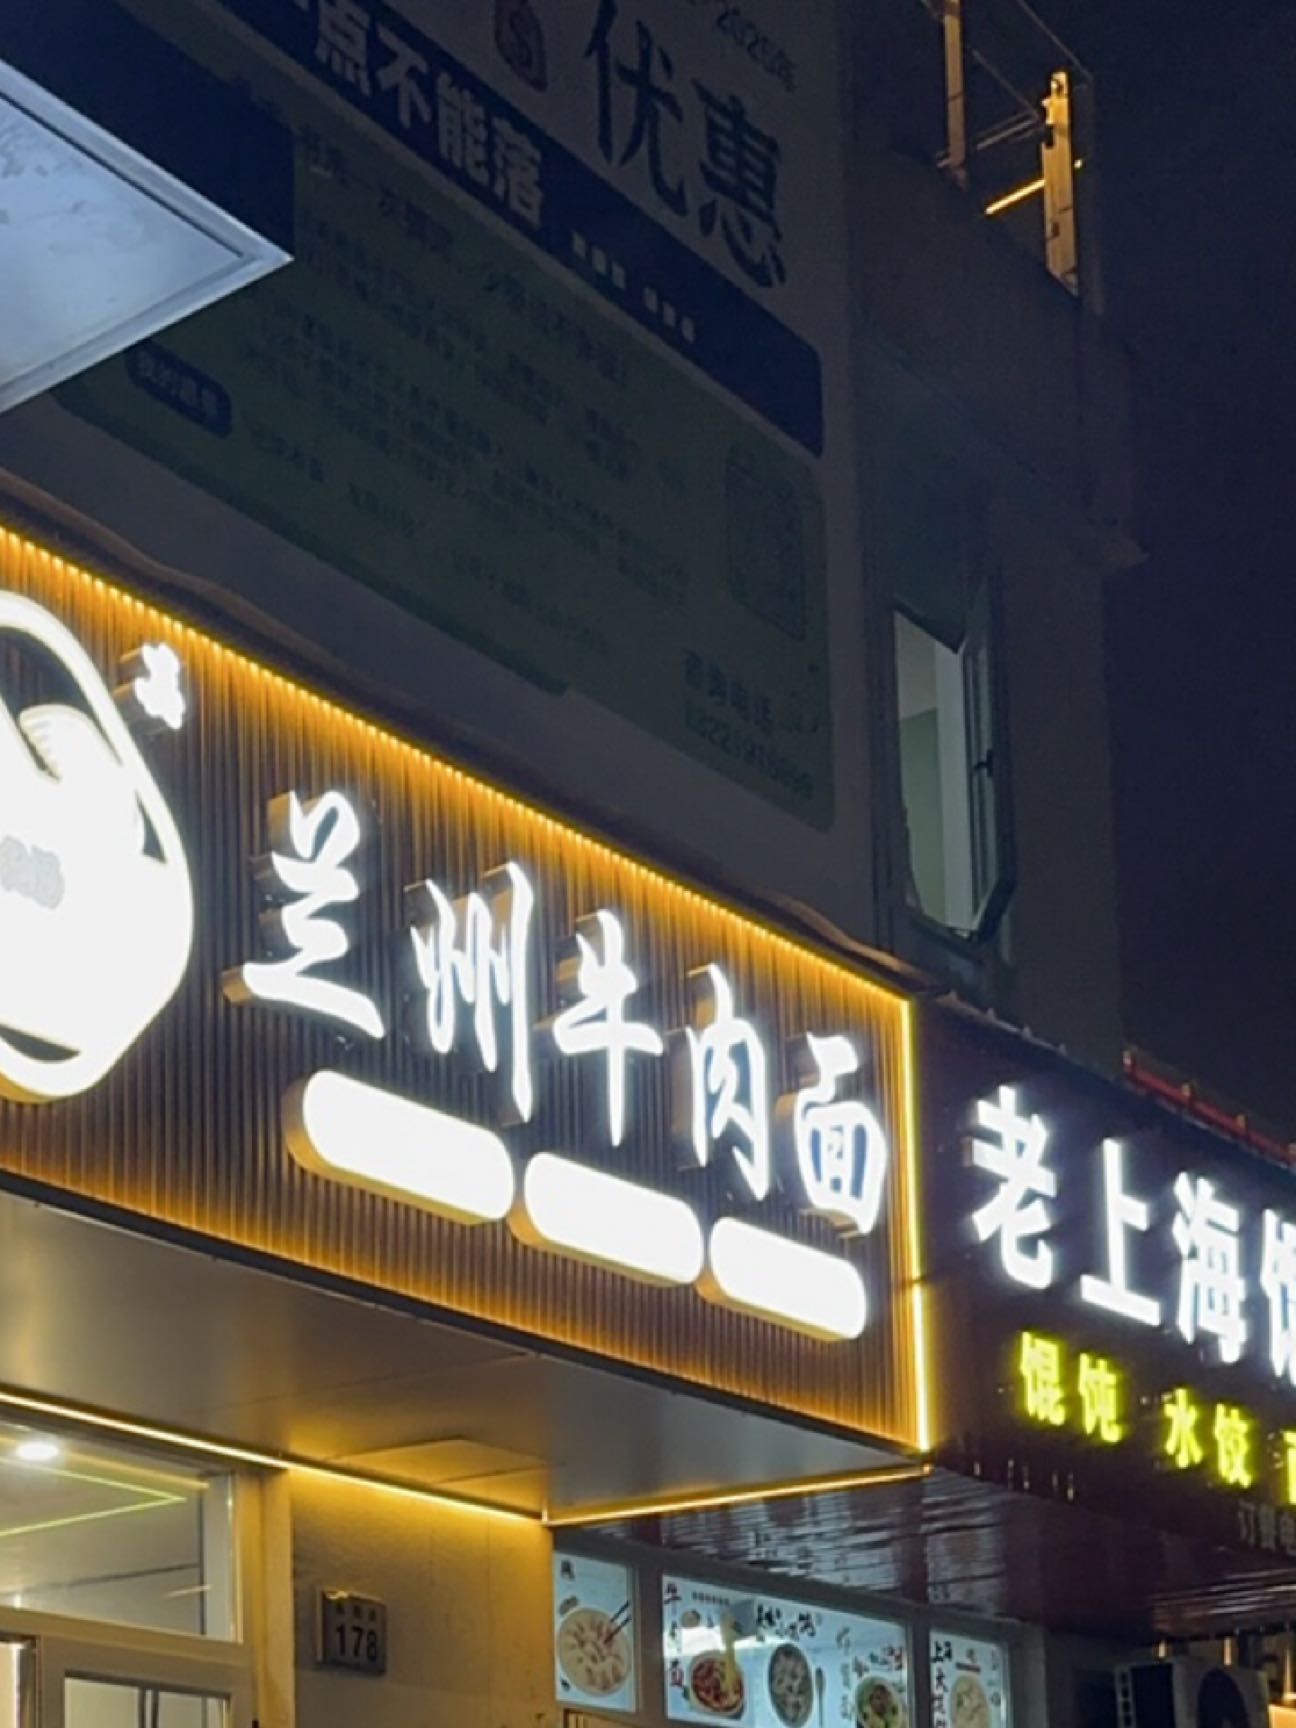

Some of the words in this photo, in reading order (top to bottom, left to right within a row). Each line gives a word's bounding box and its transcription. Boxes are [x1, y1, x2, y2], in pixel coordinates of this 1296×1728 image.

[312, 0, 546, 230] 点不能落
[583, 0, 787, 288] 优惠
[241, 790, 888, 1235] 兰州牛肉面
[1164, 1387, 1254, 1488] 水饺
[336, 1624, 377, 1663] 178
